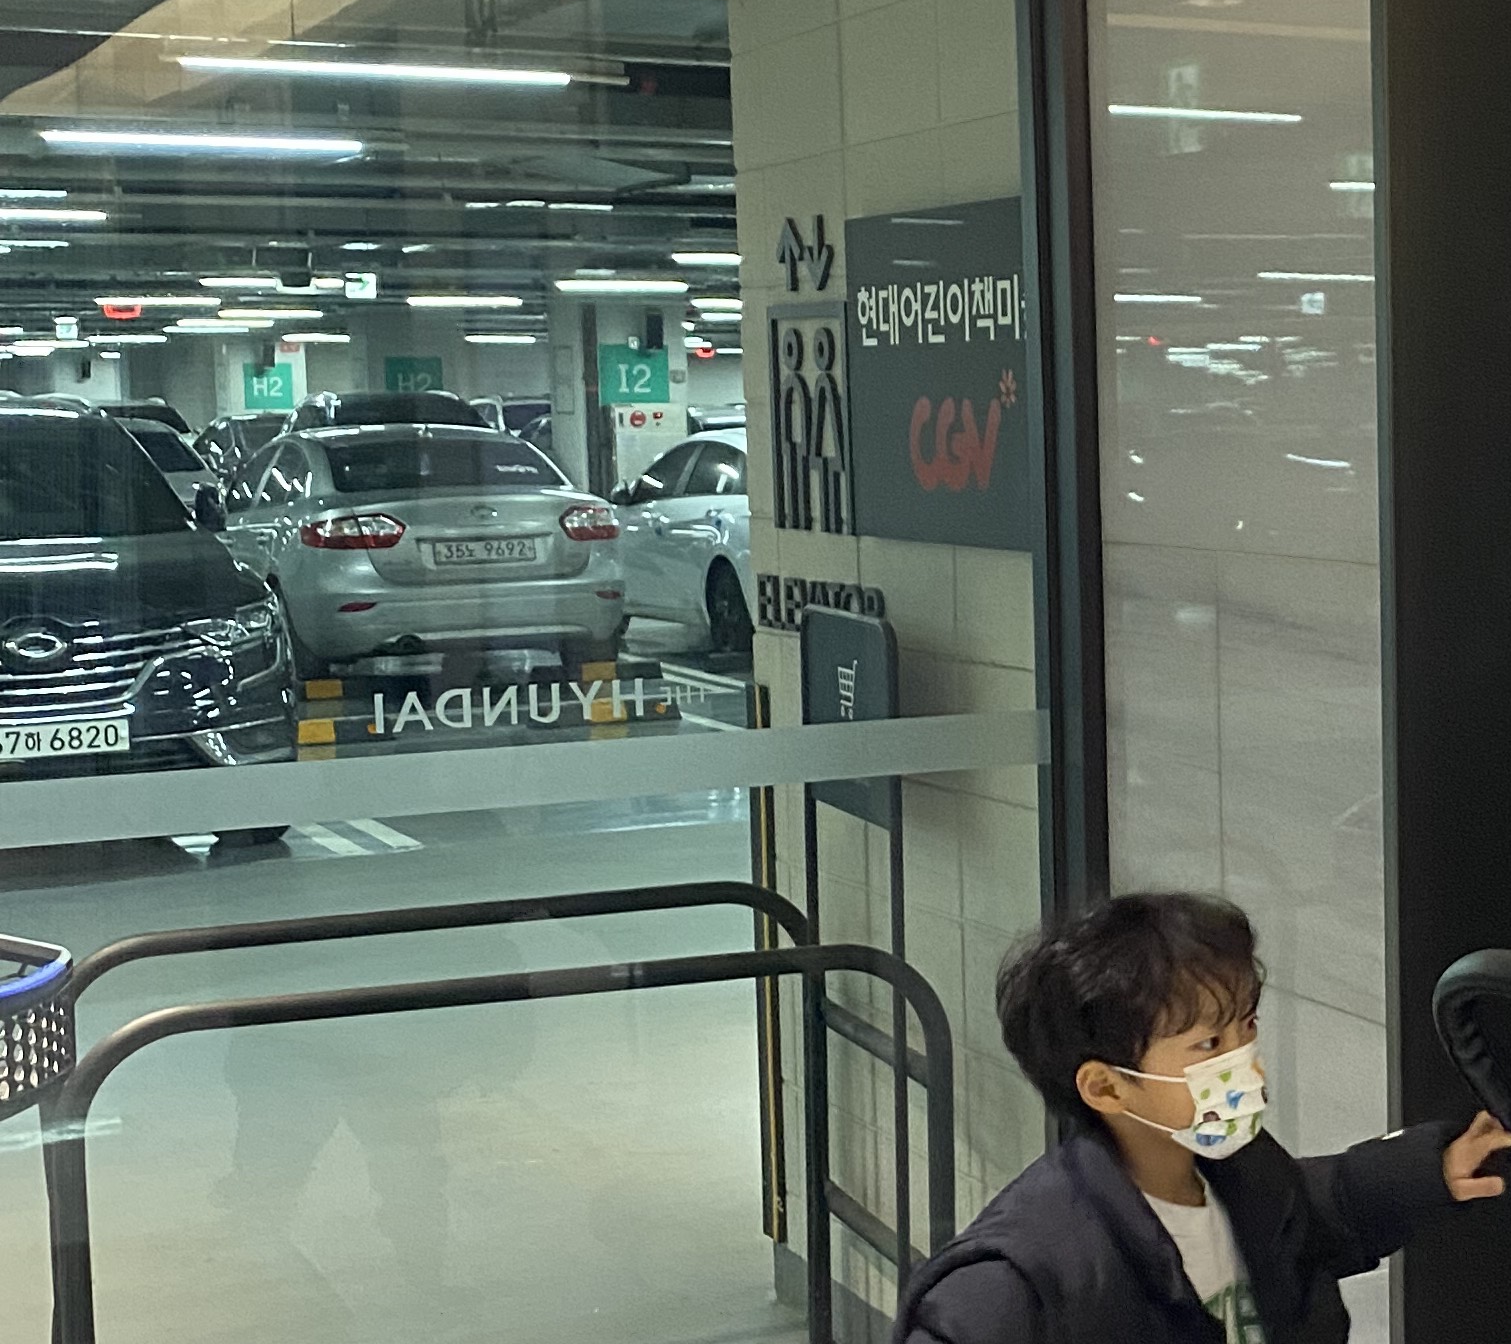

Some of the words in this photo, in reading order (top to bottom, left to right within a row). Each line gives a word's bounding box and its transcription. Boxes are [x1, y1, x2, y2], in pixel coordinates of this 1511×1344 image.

[857, 274, 1025, 346] 현대어린이책미
[252, 376, 284, 397] H2
[618, 364, 652, 394] I2
[910, 396, 1001, 491] CGV
[0, 731, 41, 755] 7하
[50, 724, 118, 751] 6820
